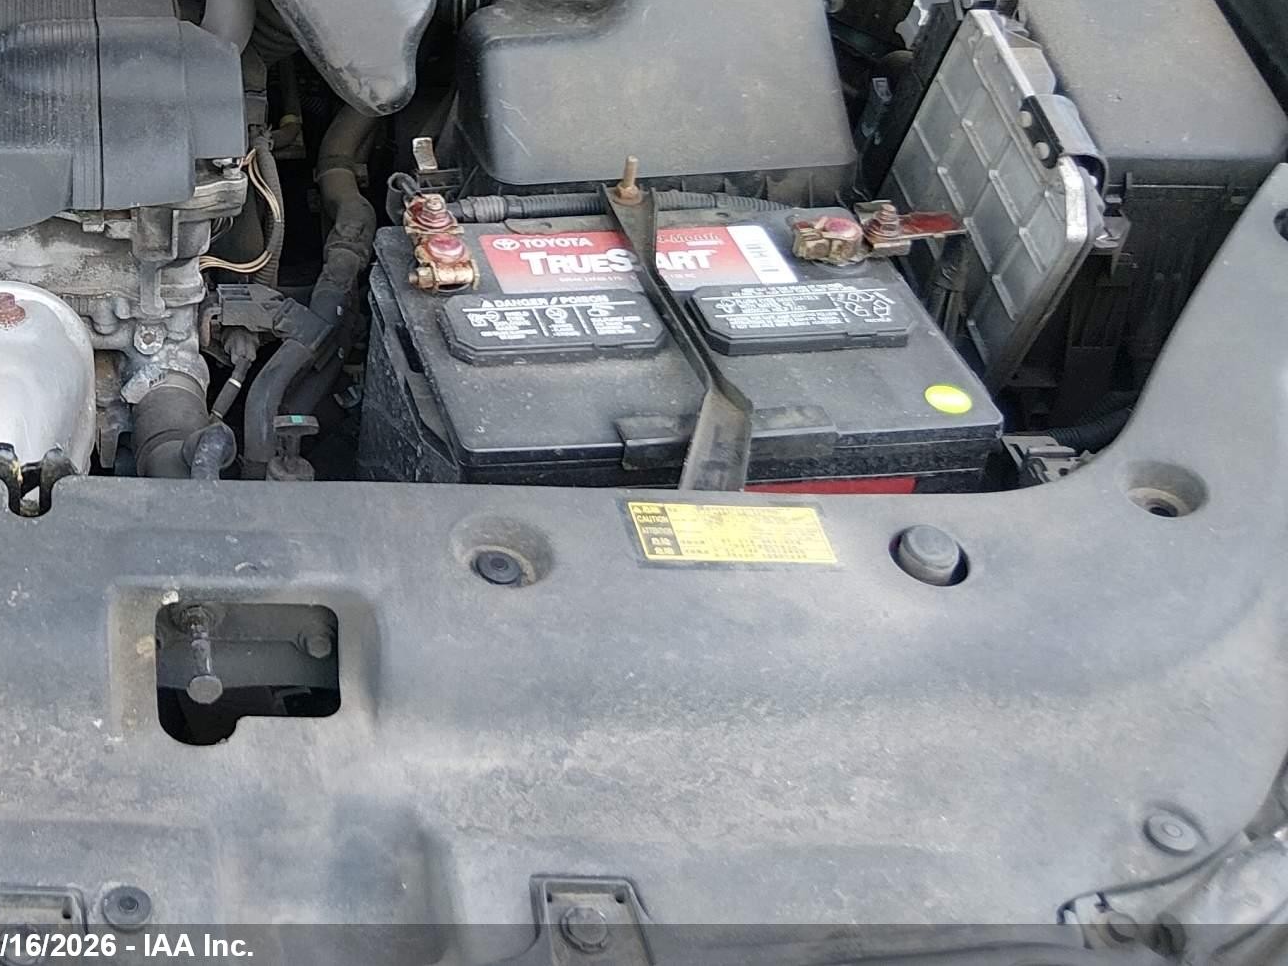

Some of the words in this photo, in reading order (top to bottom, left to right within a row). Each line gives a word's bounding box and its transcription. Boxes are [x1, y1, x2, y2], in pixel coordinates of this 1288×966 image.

[521, 237, 593, 248] TOYOTA
[520, 248, 714, 275] TRUESART
[494, 297, 549, 308] DANGER
[559, 294, 610, 305] POISON
[636, 514, 669, 523] CAUTION
